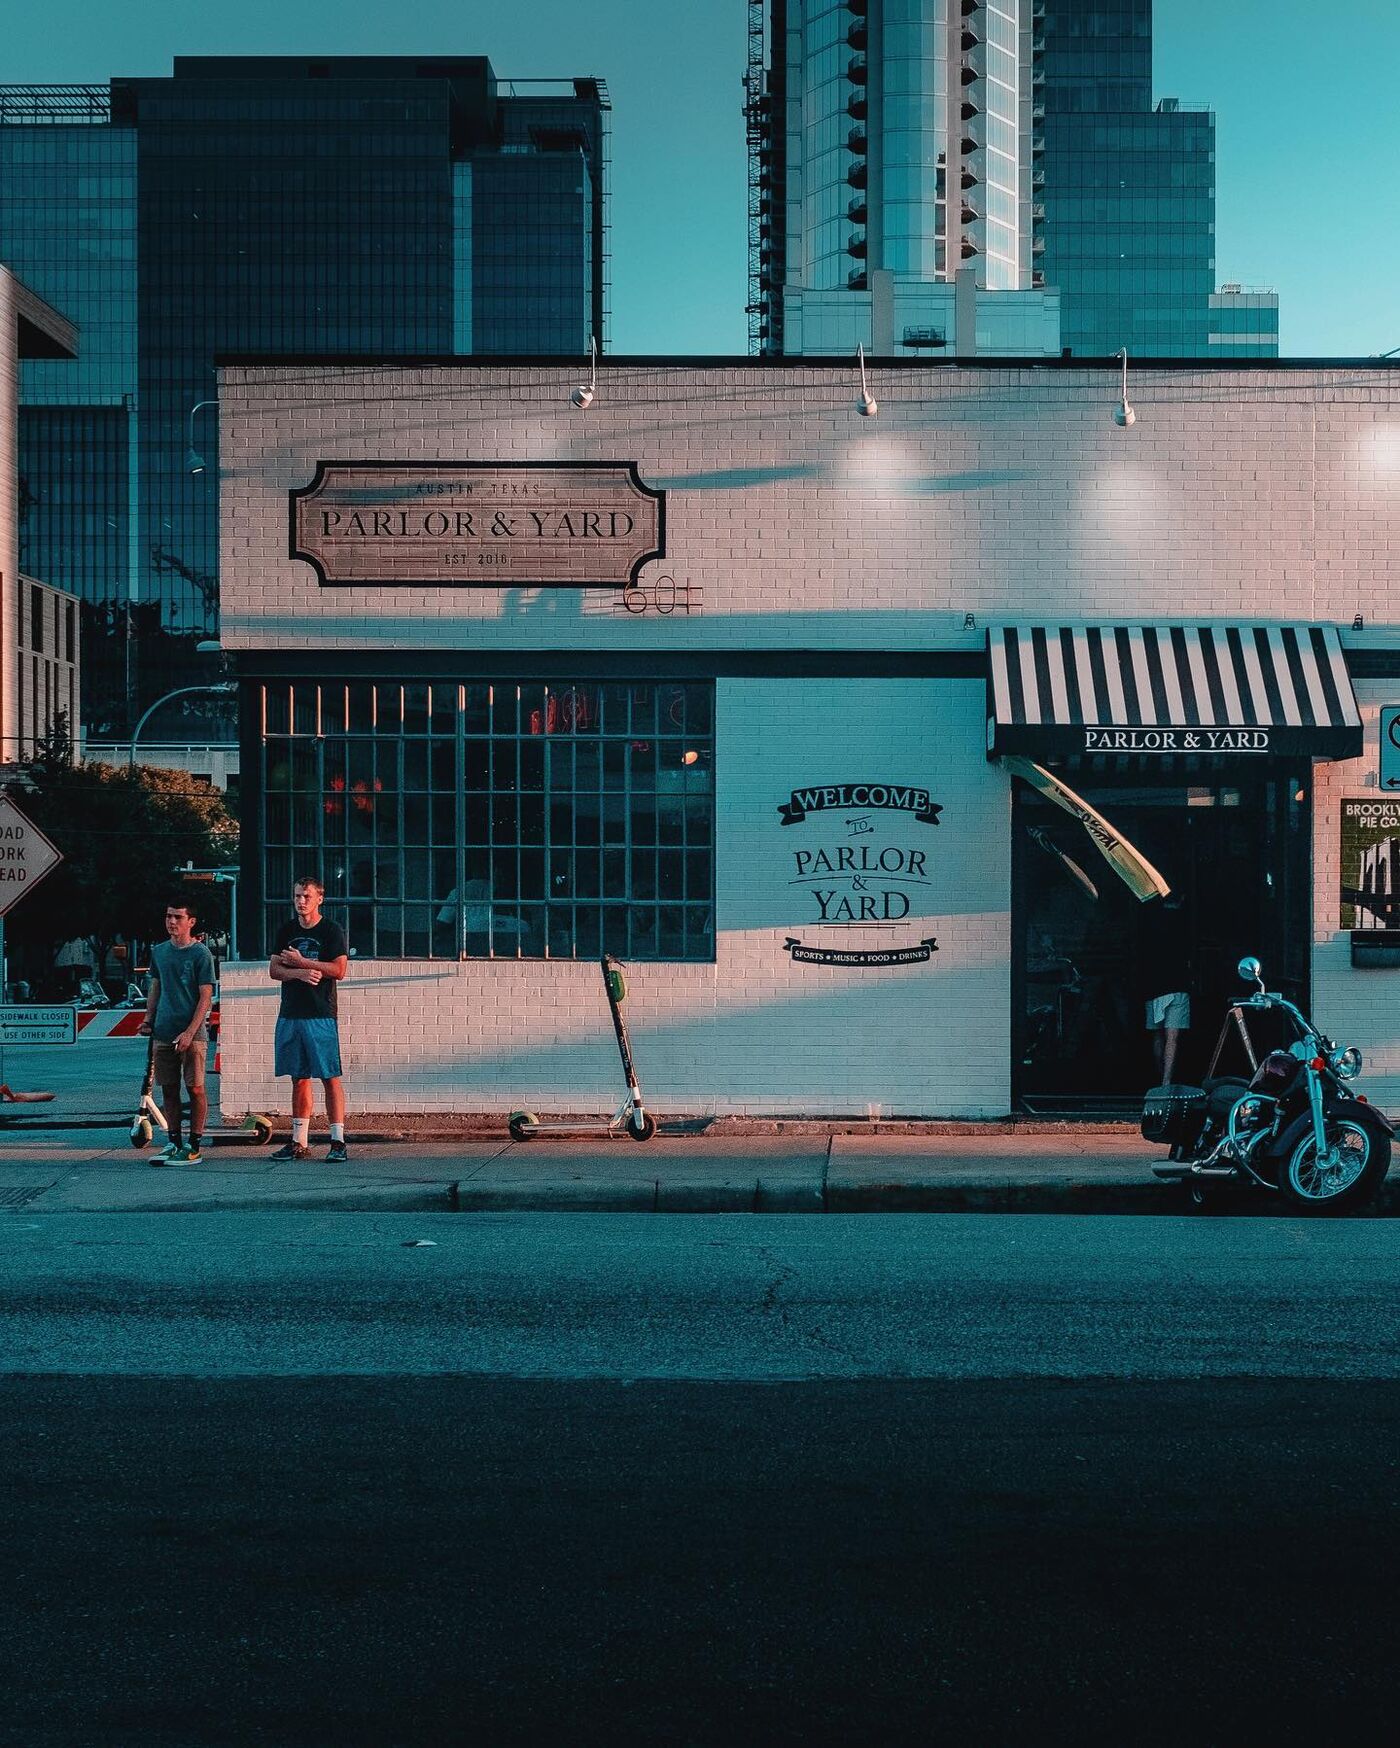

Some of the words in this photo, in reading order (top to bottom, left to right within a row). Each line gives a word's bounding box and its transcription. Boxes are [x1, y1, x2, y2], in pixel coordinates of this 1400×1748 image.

[490, 484, 540, 495] TEXAS
[320, 511, 478, 537] PARLOR
[490, 511, 518, 537] &
[528, 511, 635, 537] YARD
[1085, 732, 1177, 748] PARLOR
[1183, 732, 1201, 748] &
[1206, 732, 1269, 748] YARD
[793, 786, 928, 811] WELCOME
[852, 820, 868, 833] TO
[1360, 817, 1378, 828] PIE
[793, 846, 928, 876] PARLOR
[851, 874, 869, 891] &
[811, 890, 910, 921] YARD
[794, 950, 824, 960] SPORTS
[832, 954, 859, 962] MUSIC
[899, 950, 928, 960] DRINKS
[0, 1012, 38, 1021] SIDEWALK
[41, 1012, 70, 1020] CLOSED
[4, 1031, 18, 1039] USE
[21, 1031, 46, 1039] OTHER
[49, 1031, 66, 1039] SIDE
